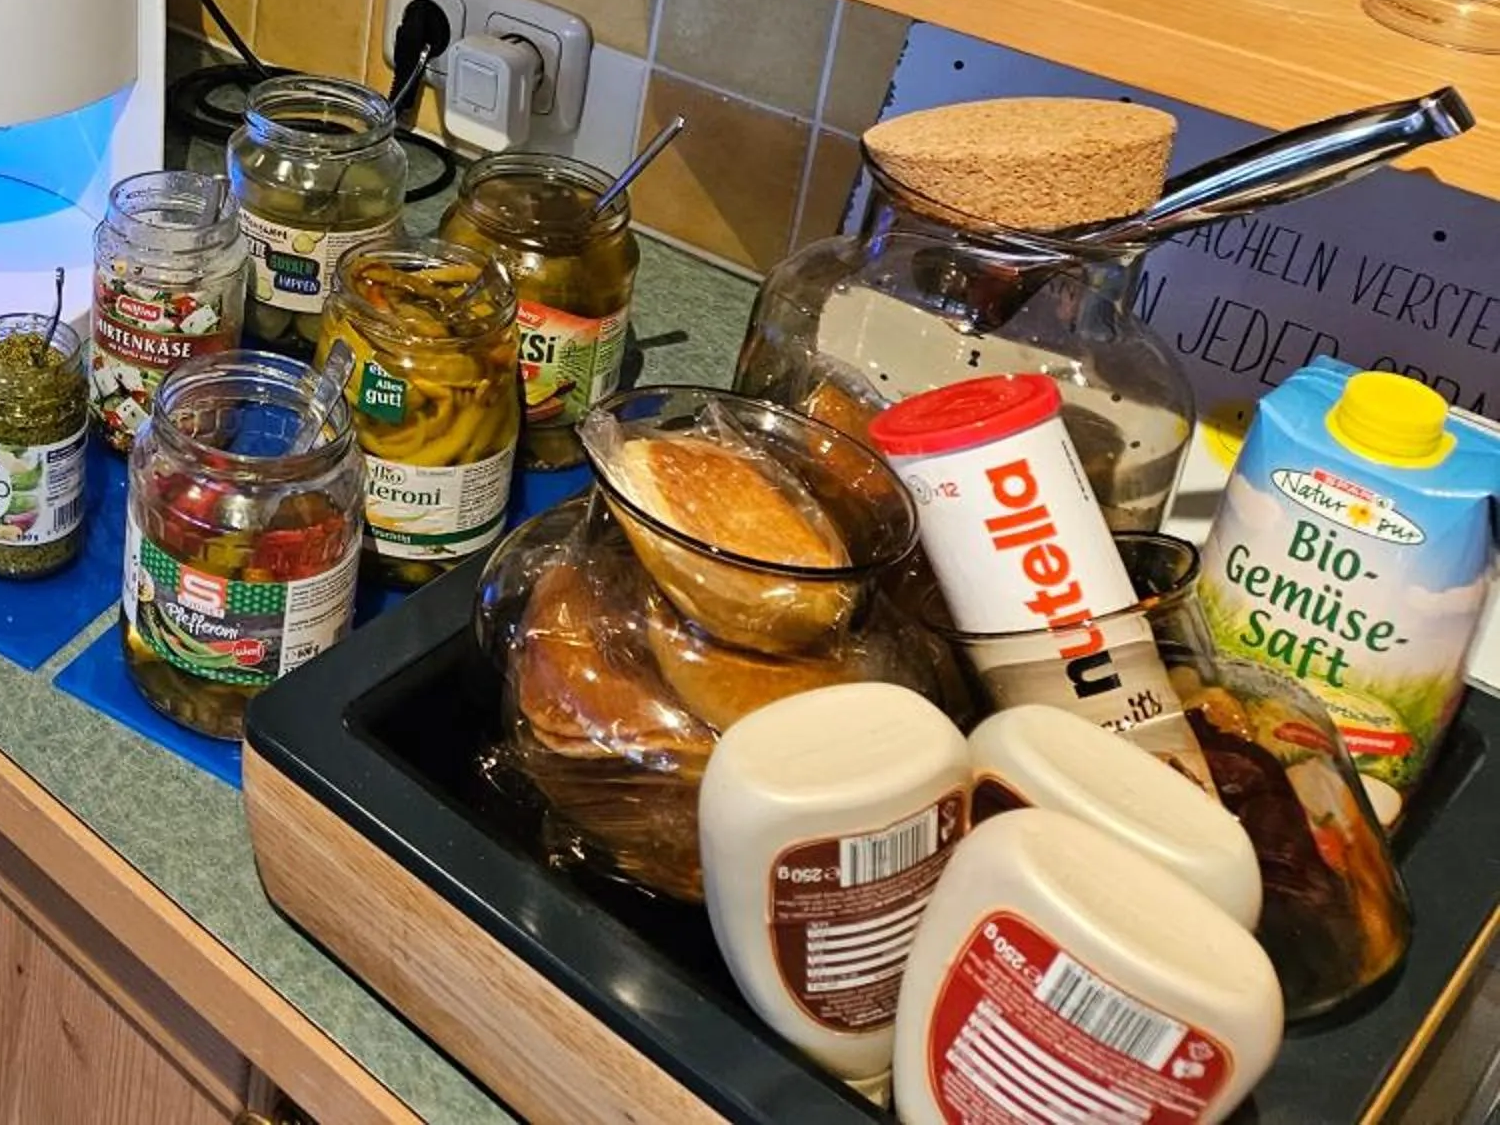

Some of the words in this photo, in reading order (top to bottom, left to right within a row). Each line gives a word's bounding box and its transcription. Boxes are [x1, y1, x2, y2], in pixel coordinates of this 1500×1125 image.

[1351, 254, 1500, 357] VERSTE
[375, 379, 403, 393] Alles
[1281, 472, 1348, 513] Natur
[1376, 517, 1420, 543] pur
[984, 458, 1123, 700] nutella
[1288, 520, 1379, 583] Bio-
[165, 602, 240, 640] Pfefferoni
[1225, 543, 1410, 653] Gemüse-
[1239, 607, 1352, 689] Saft
[790, 867, 823, 883] 250
